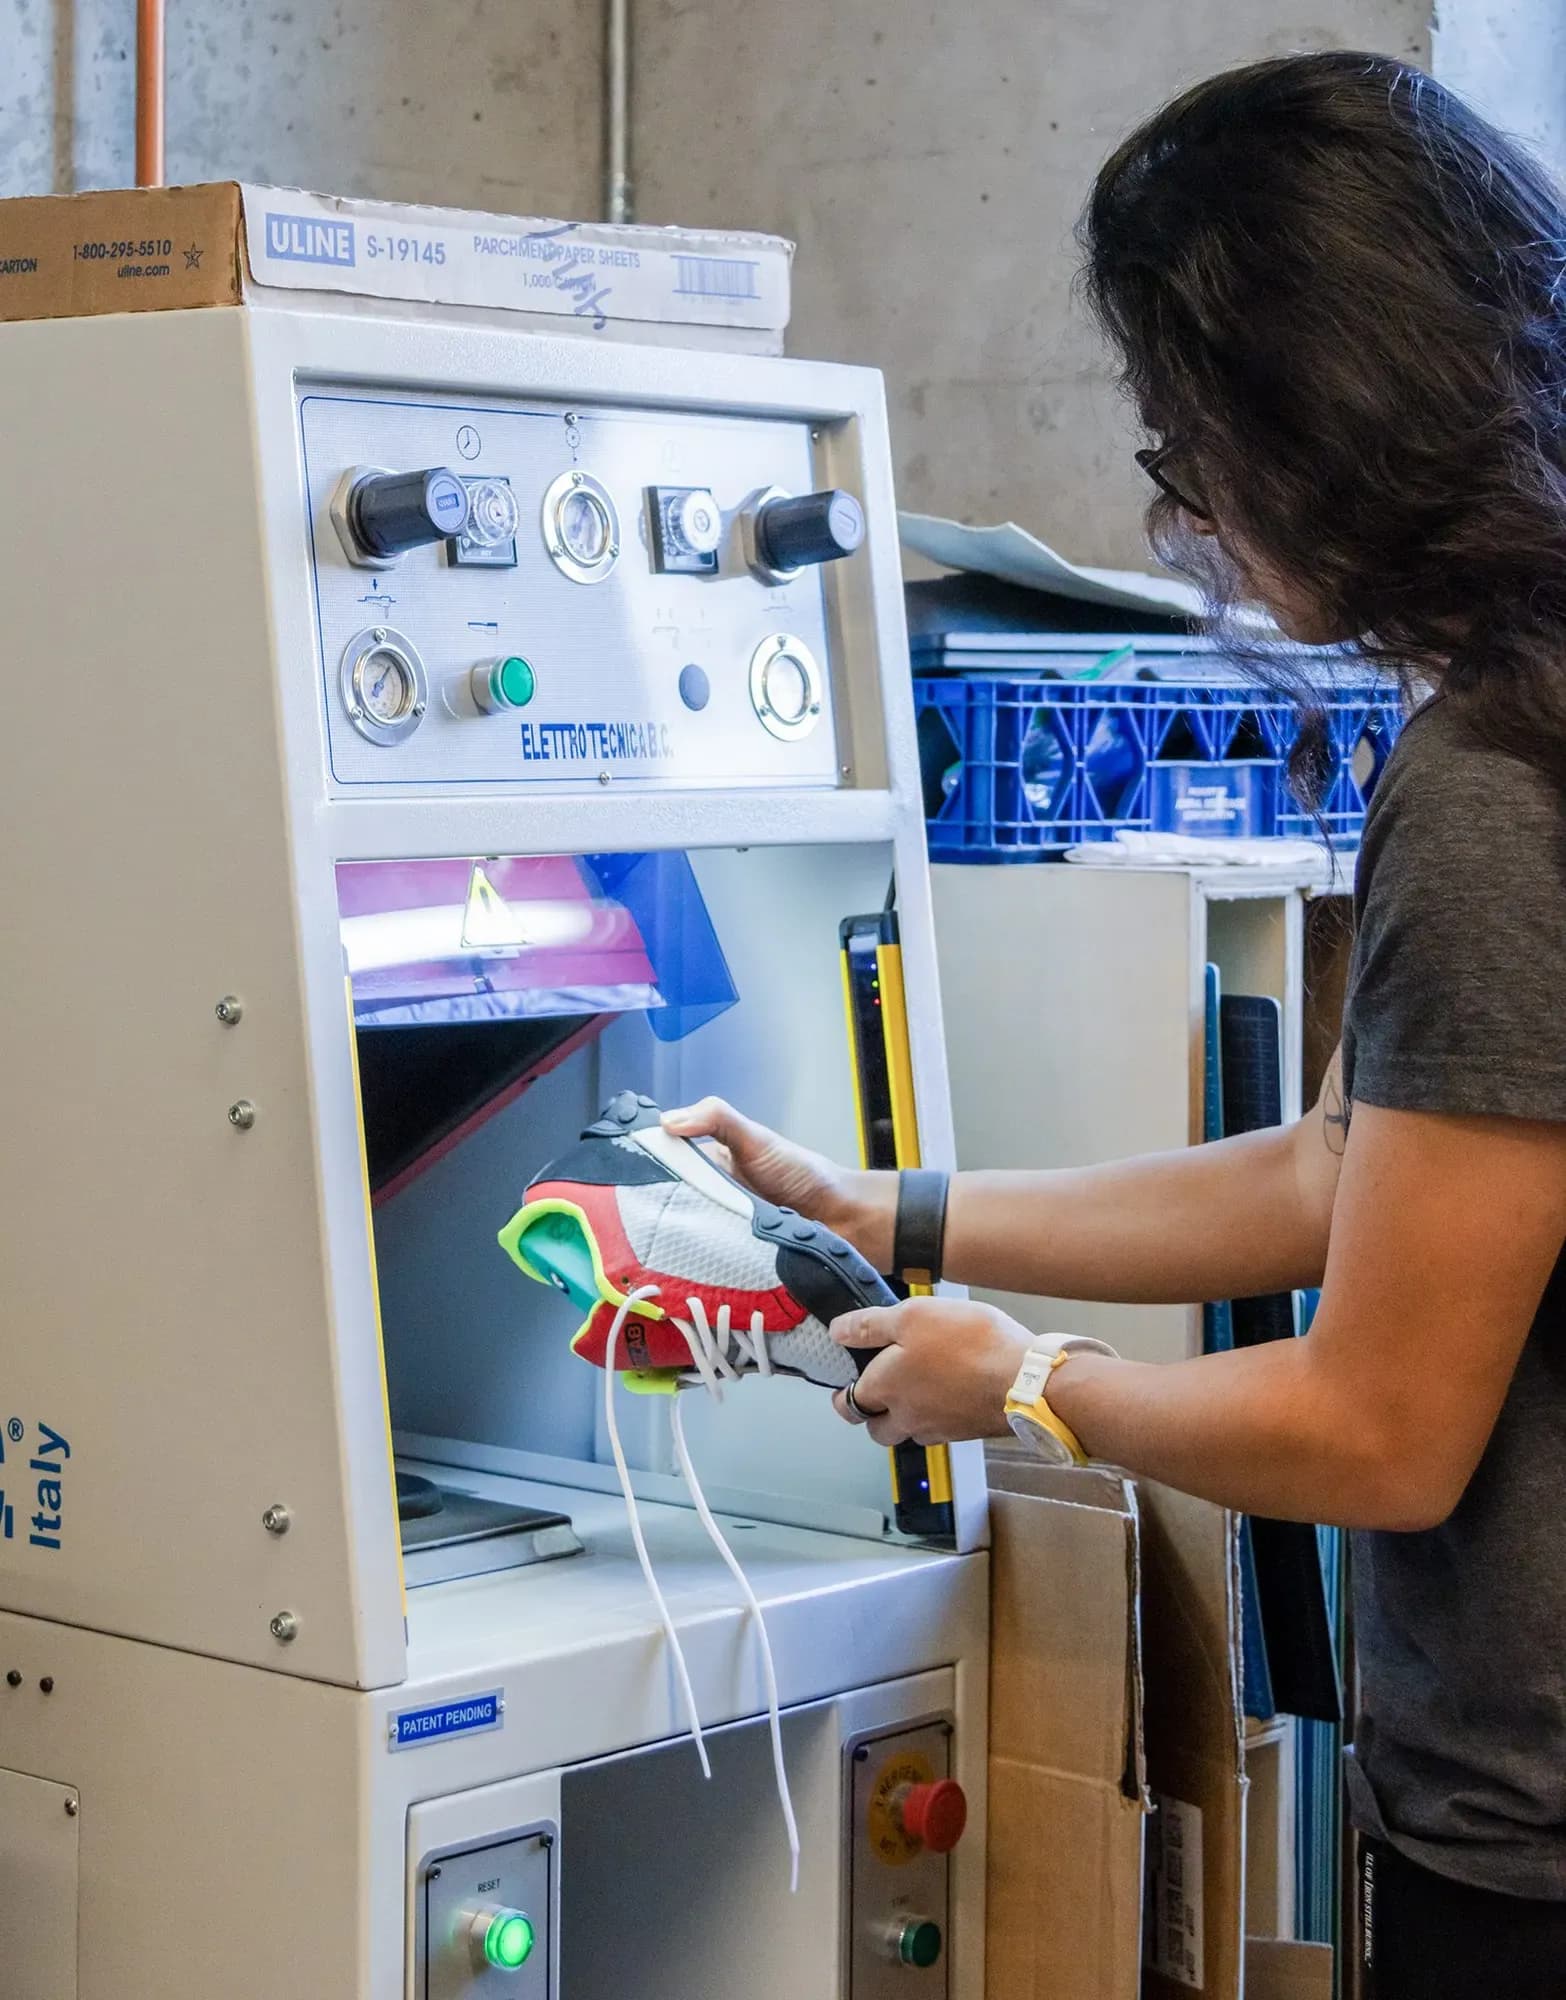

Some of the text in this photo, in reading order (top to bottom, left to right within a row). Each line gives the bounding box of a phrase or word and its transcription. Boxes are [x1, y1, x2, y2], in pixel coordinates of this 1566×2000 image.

[73, 239, 172, 260] 1-800-295-5510
[271, 220, 351, 260] ULINE
[367, 235, 446, 265] S-19145
[557, 243, 596, 265] PAPER
[599, 248, 641, 268] SHEETS
[117, 264, 170, 279] uline.com
[30, 1421, 71, 1550] Italy
[403, 1703, 492, 1736] PATENT PENDING
[477, 1878, 501, 1894] RESET
